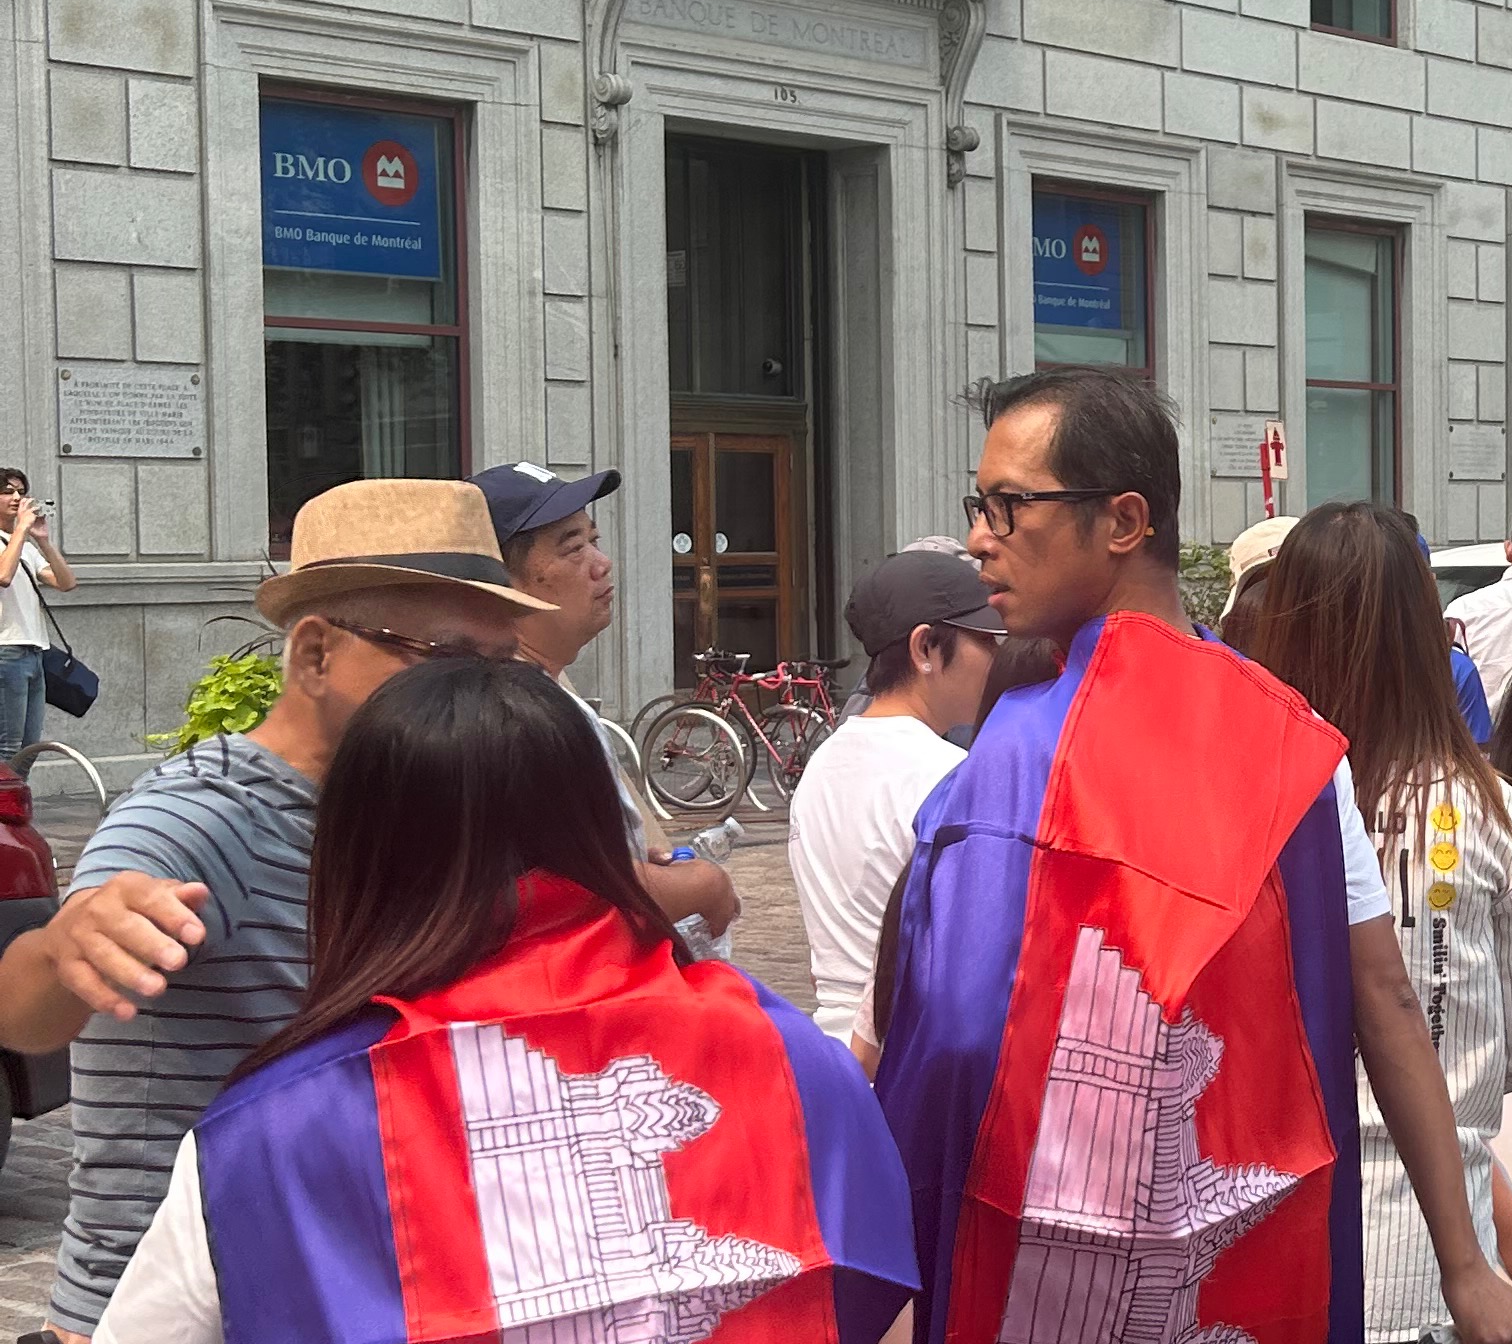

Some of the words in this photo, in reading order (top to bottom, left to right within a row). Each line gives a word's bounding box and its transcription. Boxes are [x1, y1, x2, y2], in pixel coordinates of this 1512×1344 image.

[751, 11, 779, 36] DE
[273, 152, 352, 184] BMO
[274, 226, 302, 240] BMO
[306, 228, 351, 246] Banque
[354, 232, 369, 246] de
[372, 234, 422, 251] Montréal
[1032, 236, 1067, 259] MO
[1037, 294, 1066, 308] Banque
[1067, 296, 1077, 308] de
[1078, 298, 1111, 310] Montréal
